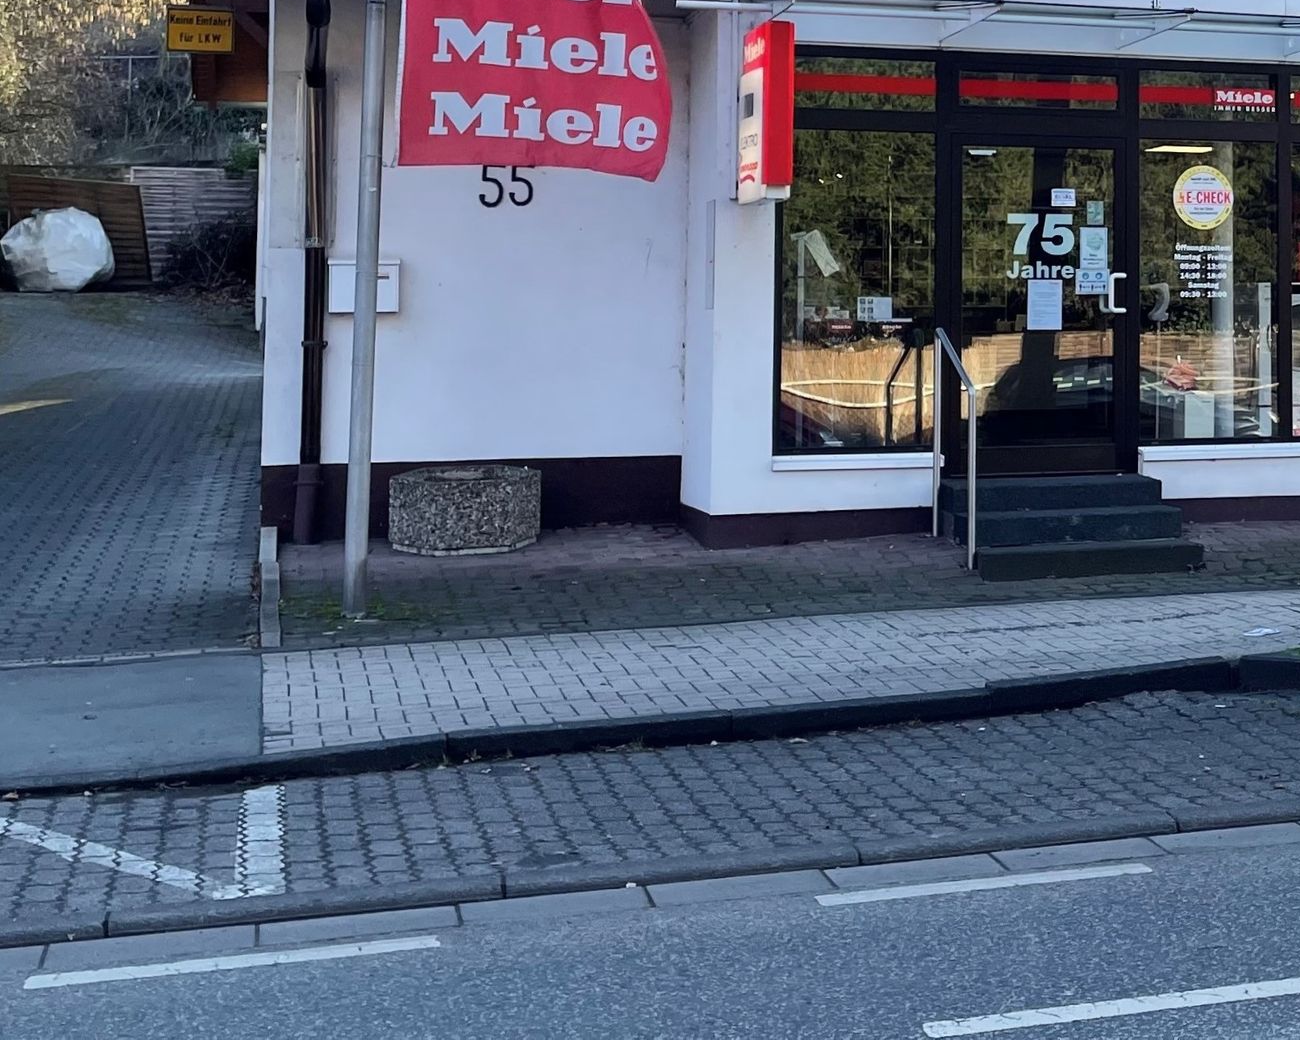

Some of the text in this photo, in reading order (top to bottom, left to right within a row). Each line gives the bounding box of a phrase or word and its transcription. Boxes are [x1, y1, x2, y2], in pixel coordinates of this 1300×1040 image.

[170, 14, 231, 27] Keine Einfahrt
[179, 32, 221, 43] für LKW
[433, 17, 658, 81] Miele
[1216, 90, 1274, 105] Miele
[428, 91, 658, 153] Miele
[478, 165, 534, 208] 55
[1186, 191, 1231, 204] E-CHECK
[1007, 213, 1075, 256] 75
[1006, 261, 1075, 279] Jahre
